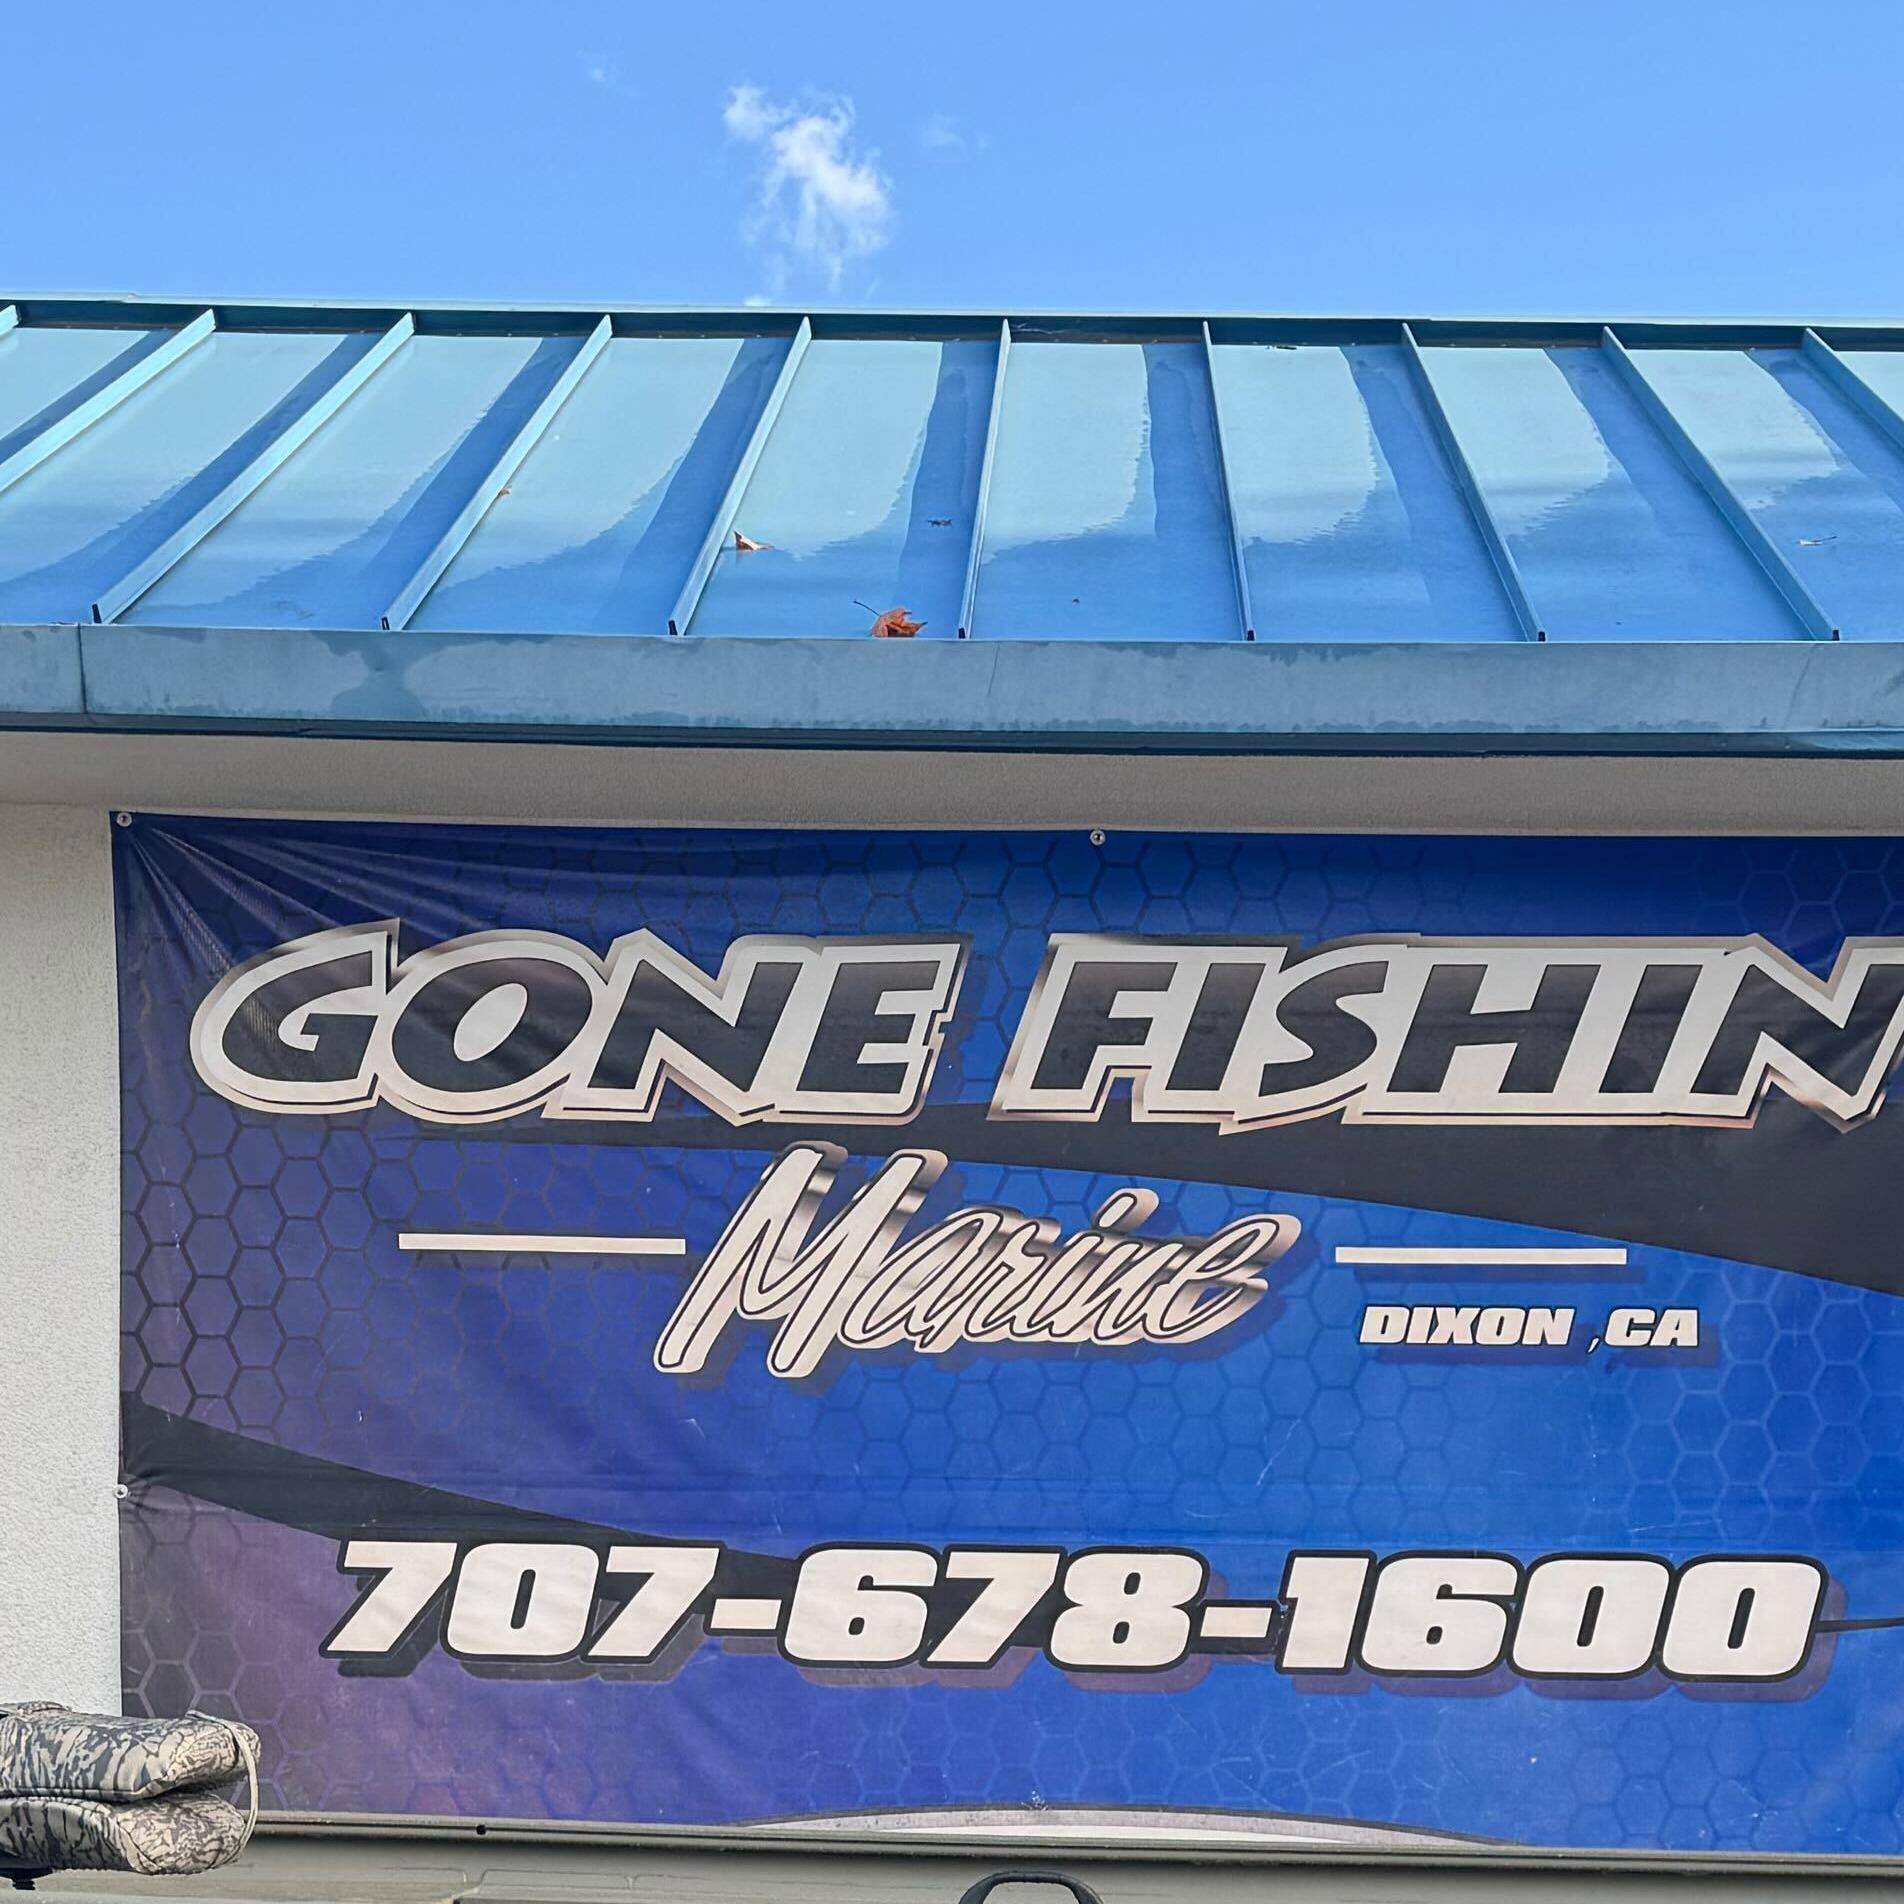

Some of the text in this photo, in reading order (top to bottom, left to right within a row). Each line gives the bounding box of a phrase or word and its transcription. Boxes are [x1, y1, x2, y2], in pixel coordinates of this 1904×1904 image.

[199, 930, 962, 1118] GONE
[654, 1142, 1301, 1376] Marine
[1358, 1305, 1576, 1346] DIXON
[325, 1540, 1826, 1680] 707-678-1600
